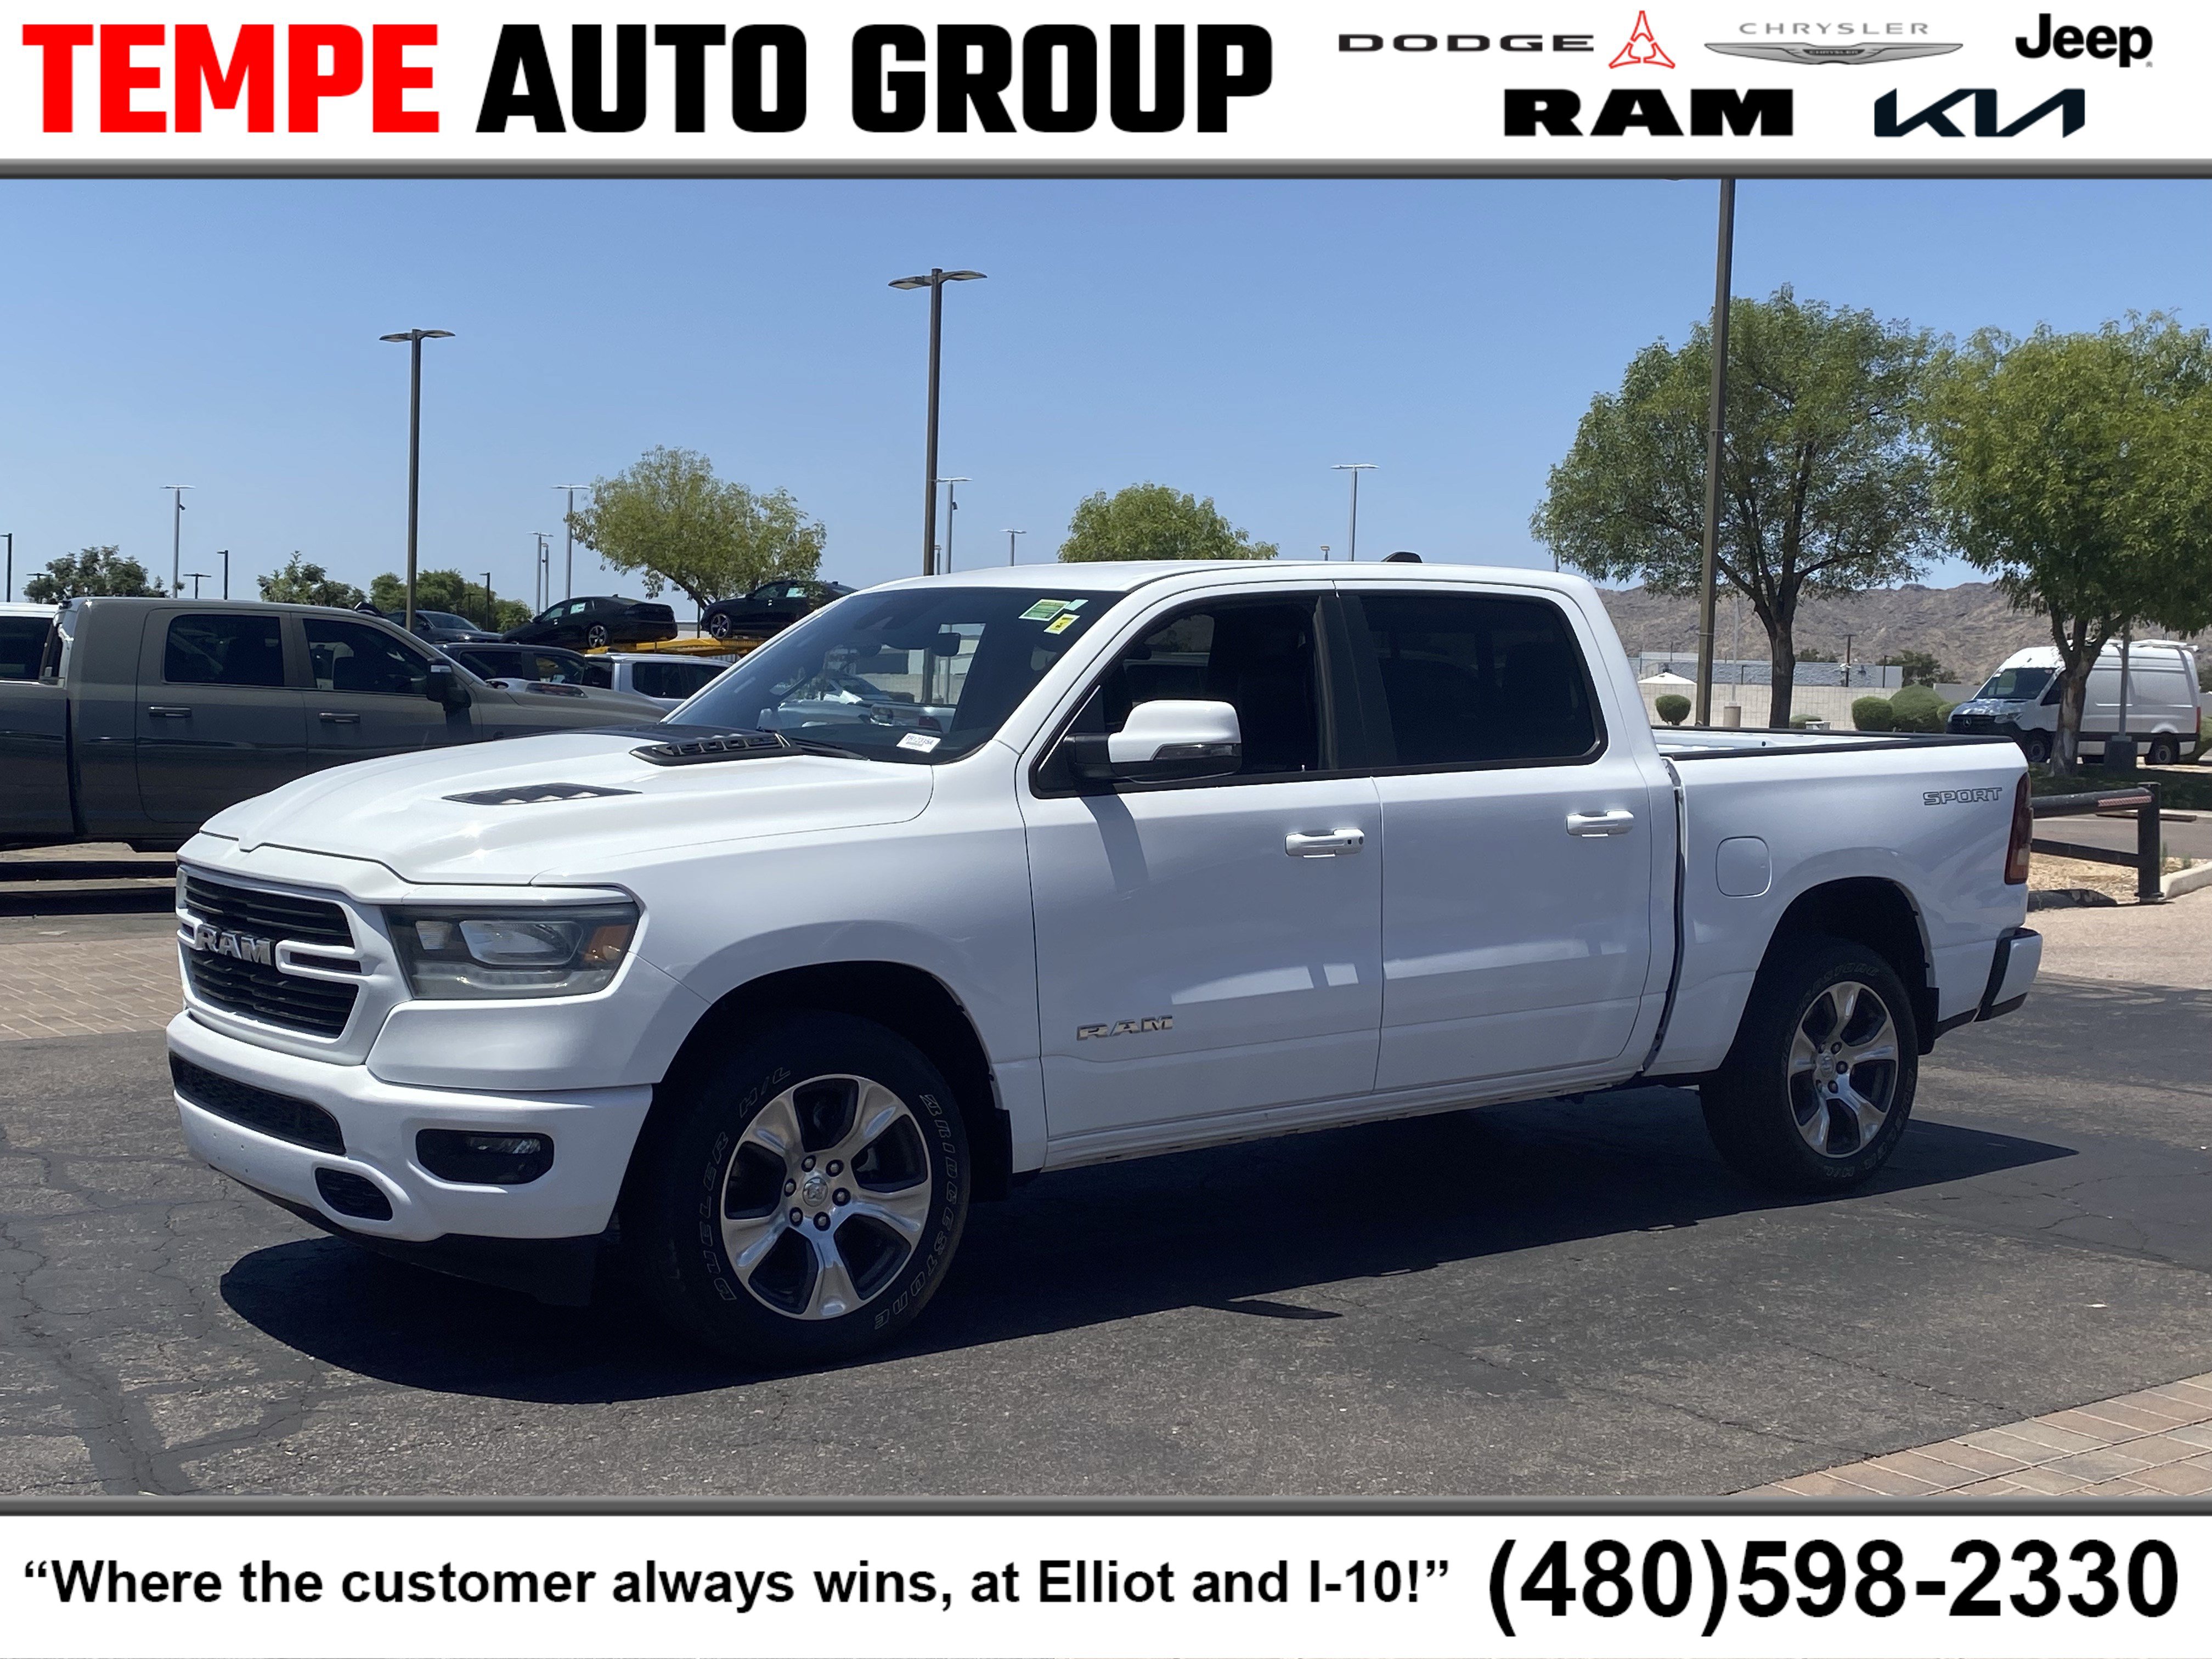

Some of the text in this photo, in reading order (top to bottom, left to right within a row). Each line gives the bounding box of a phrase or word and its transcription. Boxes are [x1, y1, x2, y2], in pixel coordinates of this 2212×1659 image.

[1923, 787, 2002, 806] SPORT
[196, 923, 277, 966] RAM
[1077, 1014, 1173, 1041] RAM
